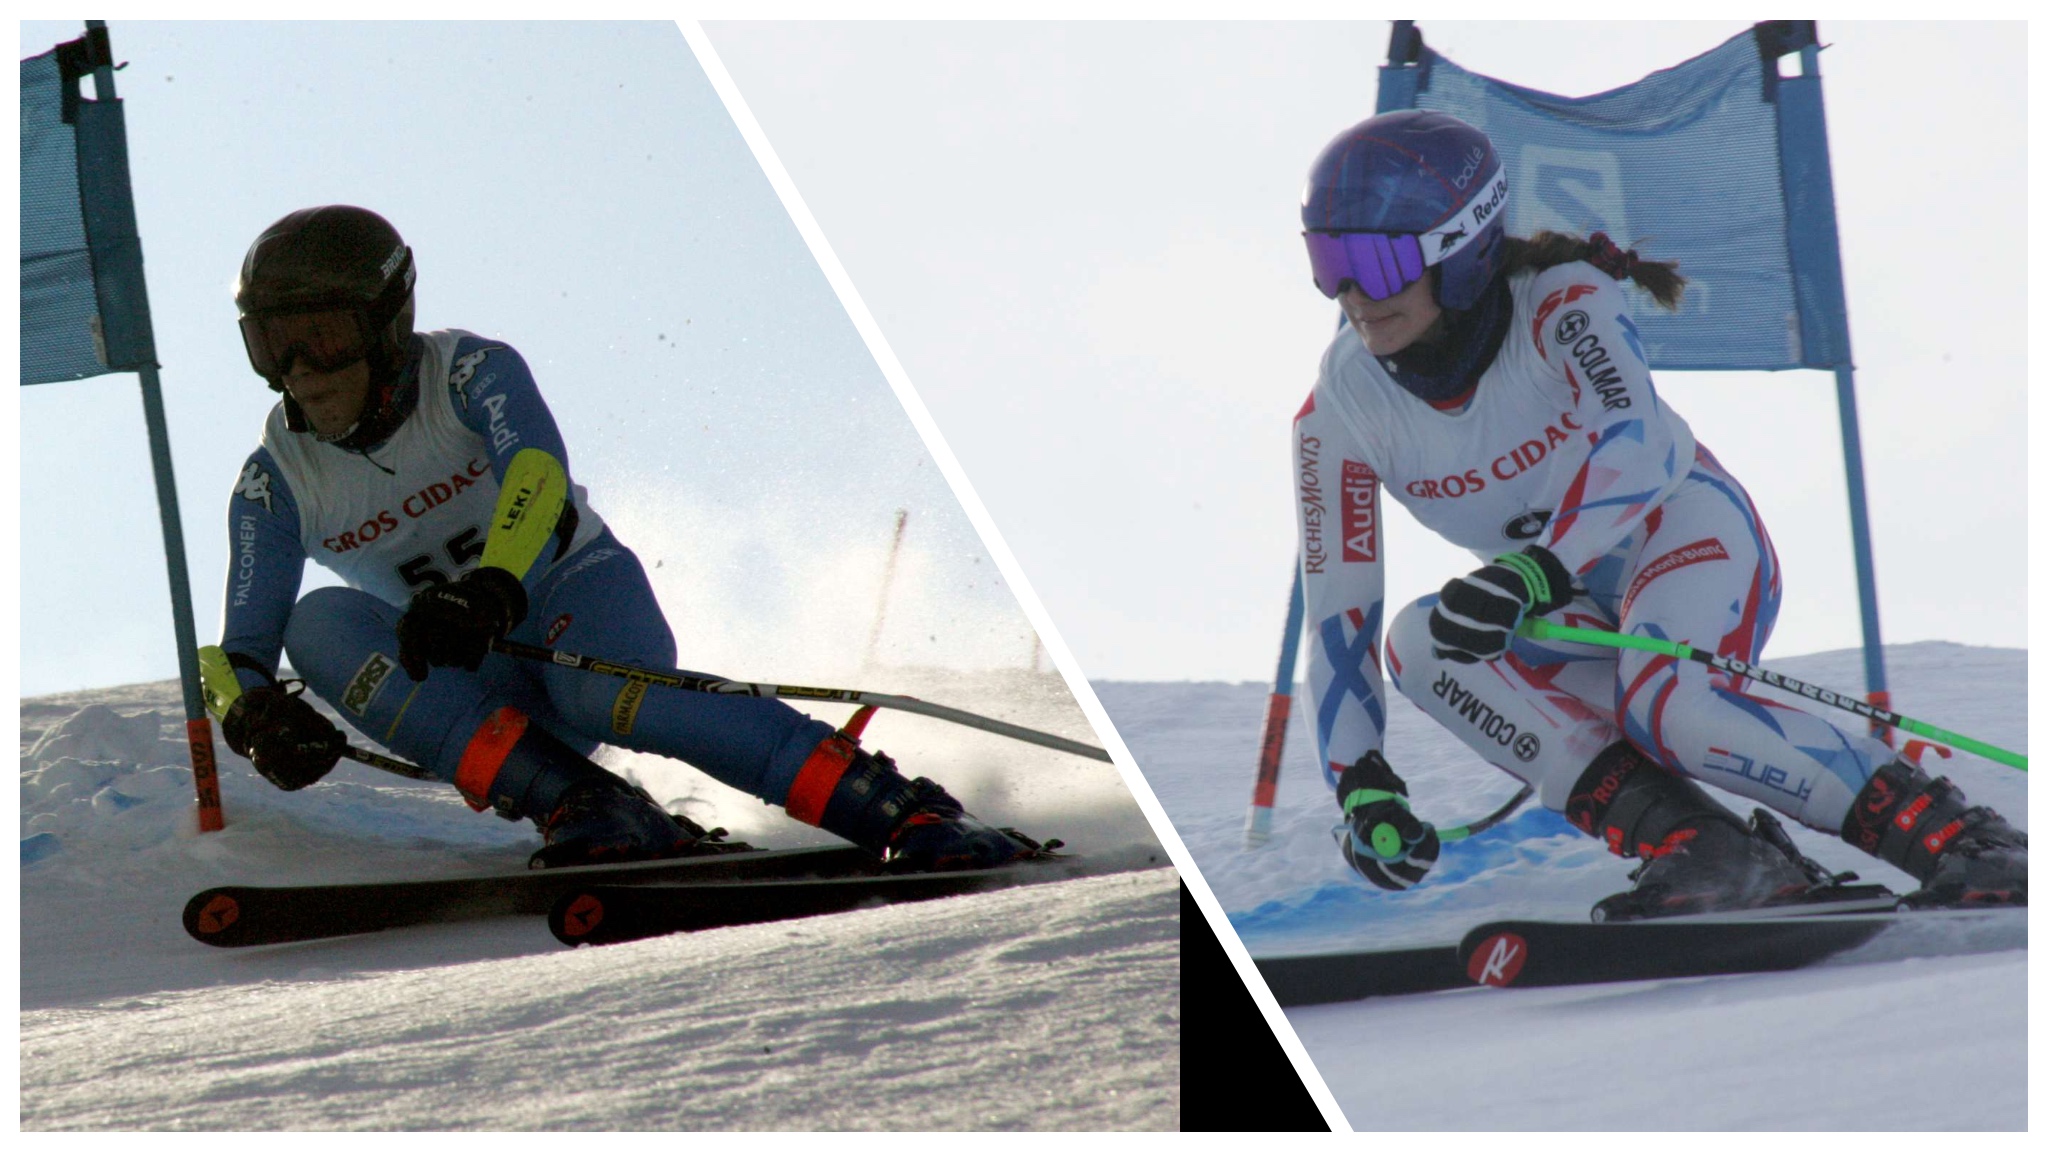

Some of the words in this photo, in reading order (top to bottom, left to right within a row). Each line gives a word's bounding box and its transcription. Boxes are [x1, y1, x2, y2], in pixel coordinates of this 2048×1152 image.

[1571, 334, 1631, 412] COLMAR
[481, 393, 519, 454] Audi
[1405, 469, 1486, 500] GROS
[1490, 412, 1583, 481] CIDAC
[322, 509, 399, 554] GROS
[402, 458, 492, 519] CIDAC
[501, 488, 531, 530] LEKI
[1345, 475, 1375, 558] Audi
[234, 515, 258, 607] FALCONERI
[395, 524, 486, 588] 55
[1683, 544, 1725, 560] Blanc
[1432, 670, 1517, 747] COLMAR
[1710, 654, 1893, 723] KOMPERDELL
